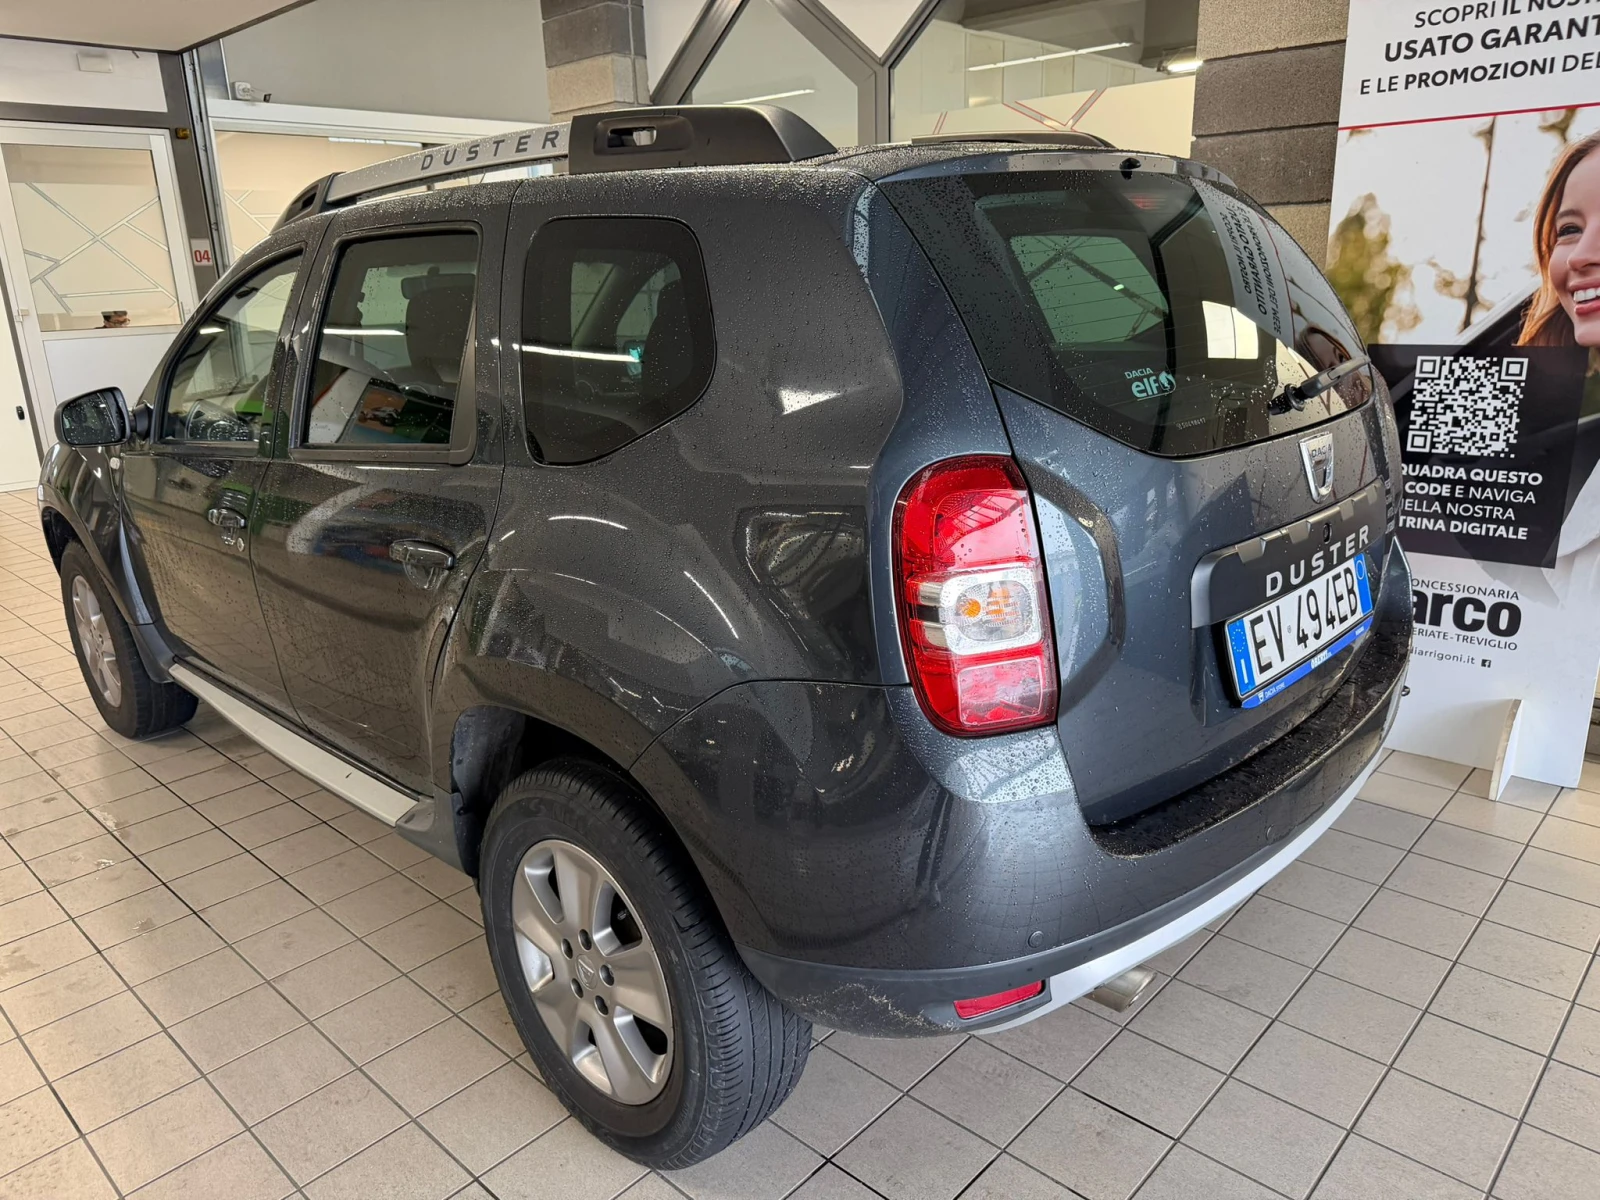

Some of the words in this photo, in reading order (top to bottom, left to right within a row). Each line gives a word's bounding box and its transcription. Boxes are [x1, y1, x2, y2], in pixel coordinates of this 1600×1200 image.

[1414, 1, 1495, 28] SCOPRI
[1502, 0, 1521, 15] IL
[1385, 32, 1474, 62] USATO
[1360, 79, 1371, 95] E
[1377, 75, 1399, 93] LE
[1404, 57, 1555, 90] PROMOZIONI
[421, 130, 560, 171] DUSTER
[194, 250, 211, 263] 04
[1124, 367, 1153, 379] DACIA
[1131, 376, 1159, 398] elf
[1470, 468, 1543, 486] QUESTO
[1404, 481, 1451, 497] CODE
[1455, 485, 1464, 497] E
[1469, 486, 1536, 504] NAVIGA
[1402, 498, 1442, 514] ELLA
[1446, 502, 1516, 521] NOSTRA
[1450, 520, 1529, 540] DIGITALE
[1266, 525, 1369, 597] DUSTER
